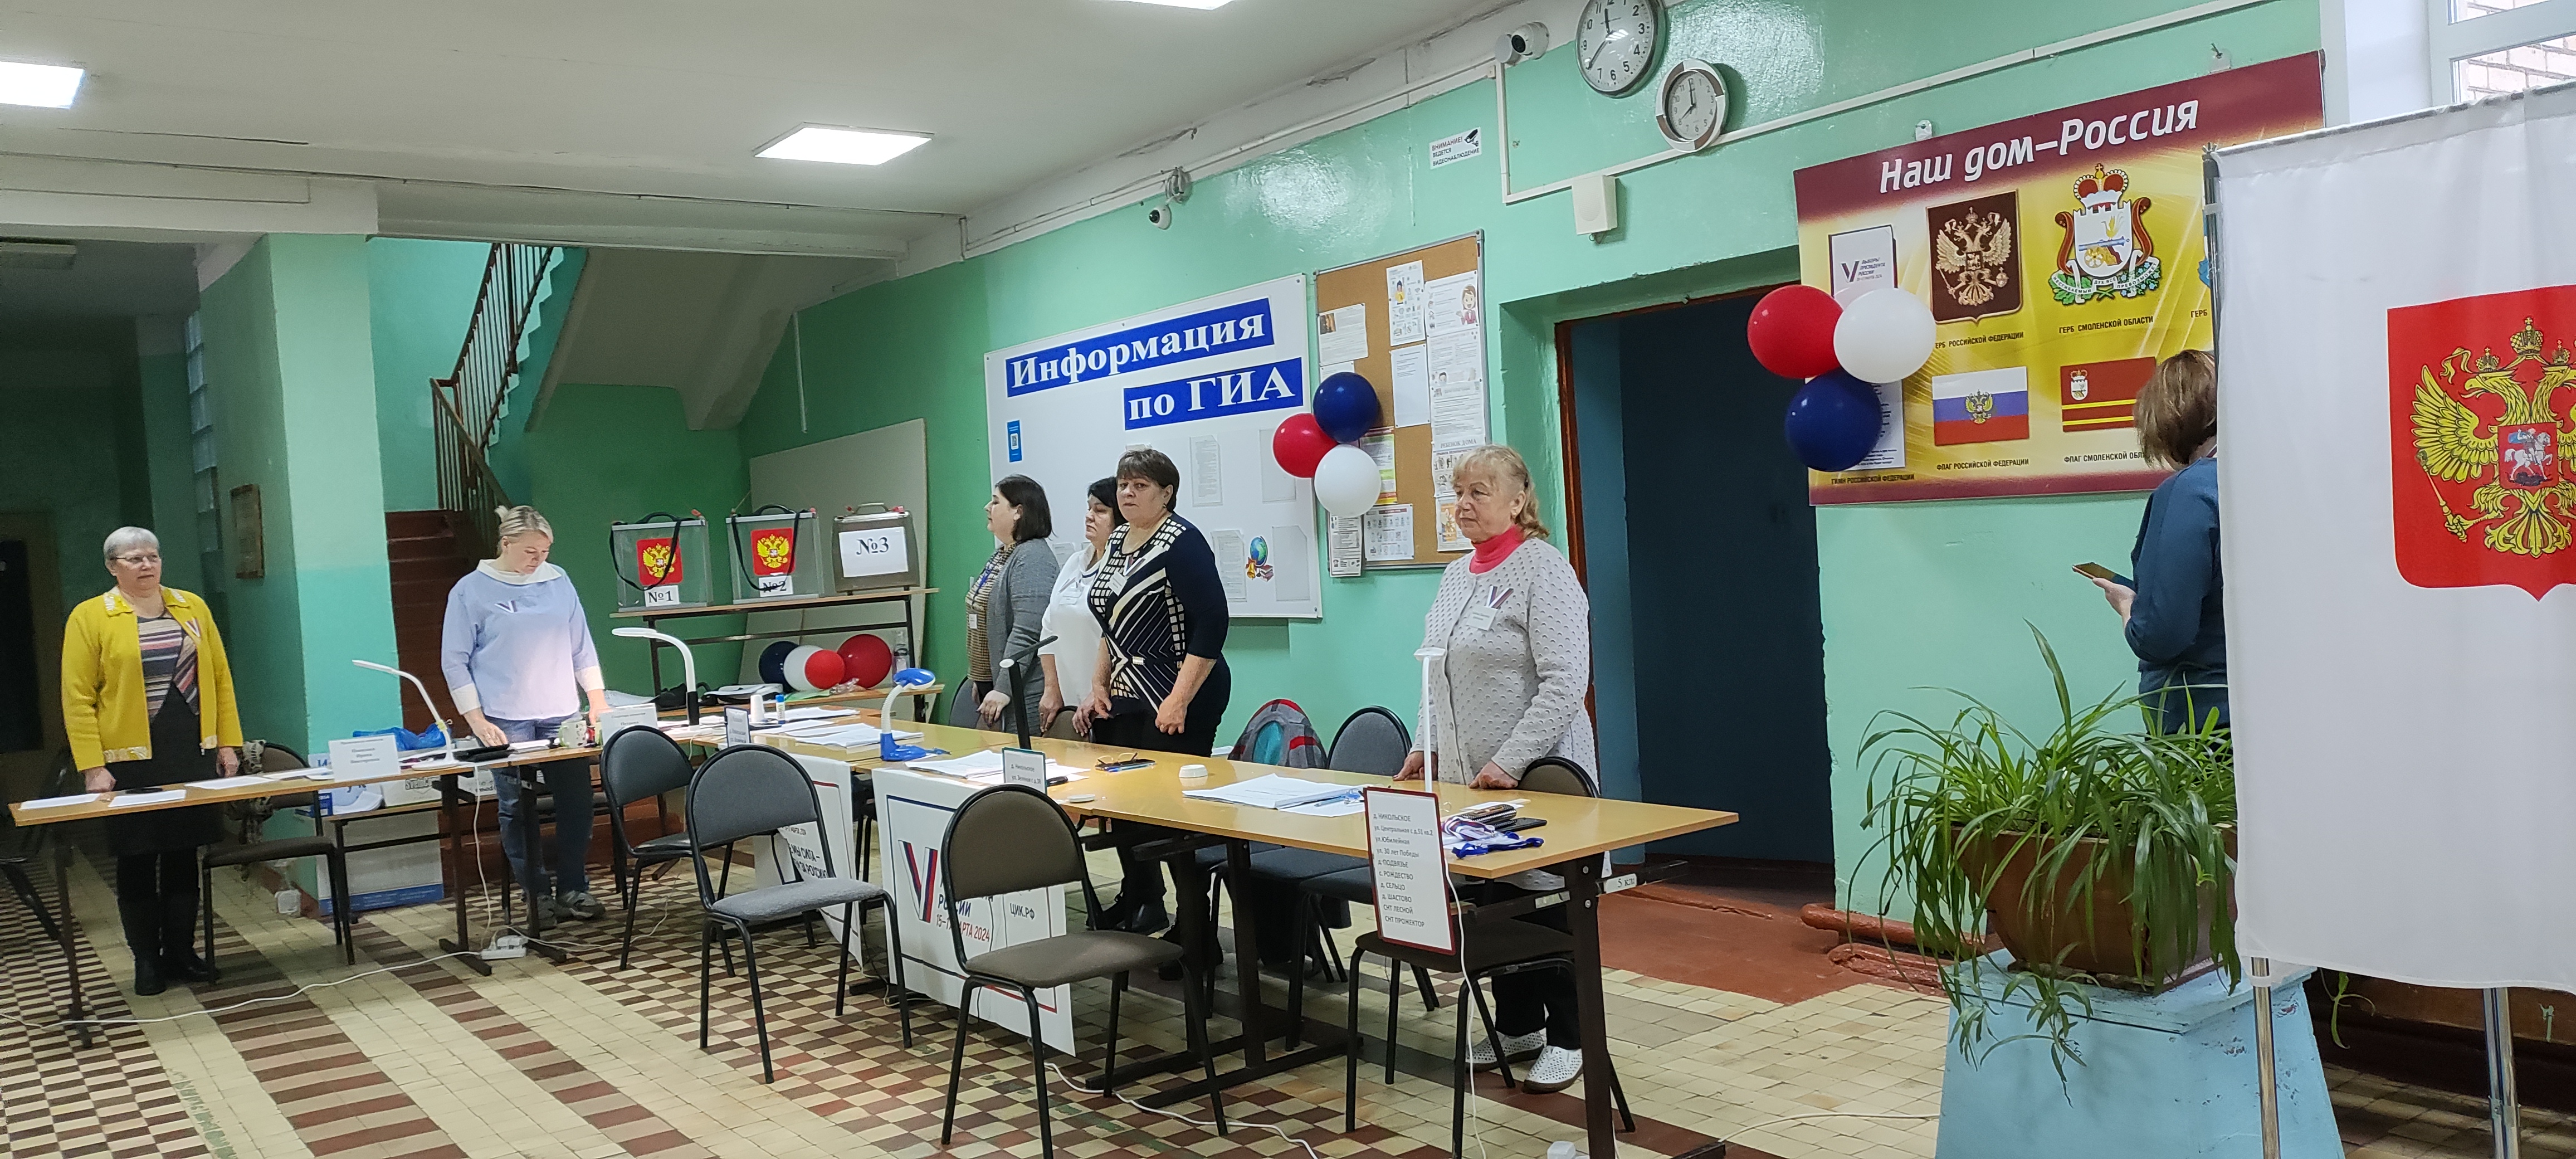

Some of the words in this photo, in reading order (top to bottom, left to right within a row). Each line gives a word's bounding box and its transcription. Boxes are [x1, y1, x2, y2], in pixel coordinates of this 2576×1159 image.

[1632, 4, 1640, 16] 2
[1638, 23, 1645, 35] 3
[1583, 40, 1587, 51] 9
[1633, 44, 1641, 55] 4
[1623, 61, 1630, 72] 5
[1597, 67, 1602, 79] 7
[1610, 70, 1617, 80] 6
[1432, 136, 1463, 151] ВНИМАНИЕ!
[1433, 147, 1452, 158] ВЕДЕТСЯ
[1433, 148, 1480, 166] ВИДЕОНАБЛЮДЕНИЕ
[1879, 153, 1952, 193] Наш
[2052, 276, 2091, 294] НЕСГИБАЕМЫЙ
[2117, 262, 2157, 289] ПРЕВОЗМОЖЕТ
[2190, 309, 2208, 319] ГЕРБ
[2058, 325, 2075, 334] ГЕРБ
[2077, 318, 2123, 332] СМОЛЕНСКОЙ
[2123, 315, 2154, 327] ОБЛАСТИ
[1935, 341, 1946, 349] ЕРБ
[1948, 334, 1987, 348] РОССИЙСКОЙ
[1988, 330, 2024, 343] ФЕДЕРАЦИИ
[1011, 314, 1266, 389] Информация
[1129, 389, 1175, 421] по
[1187, 366, 1296, 412] ГИА
[1461, 438, 1477, 446] ДОМА
[2064, 455, 2082, 463] ФЛАГ
[2083, 451, 2128, 462] СМОЛЕНСКОЙ
[1936, 462, 1953, 471] ФЛАГ
[1953, 459, 1992, 470] РОССИЙСКОЙ
[1993, 458, 2029, 468] ФЕДЕРАЦИИ
[1847, 474, 1881, 484] РОССИЙСКОЙ
[1882, 473, 1915, 482] ФЕДЕРАЦИИ
[1378, 814, 1411, 822] НИКОЛЬСКОЕ
[1380, 825, 1409, 834] Центральная
[1399, 850, 1419, 858] Победы
[1383, 870, 1413, 880] РОЖДЕСТВО
[1386, 882, 1405, 890] СЕЛЬЦО
[1618, 878, 1622, 888] 5
[1387, 894, 1412, 903] ШАСТОВО
[938, 894, 972, 917] РОИИ
[1009, 903, 1035, 919] ЦИК.РФ
[1393, 905, 1413, 914] ЛЕСНОЙ
[1394, 917, 1424, 927] ПРОЖЕКТОР
[974, 926, 989, 942] 2024
